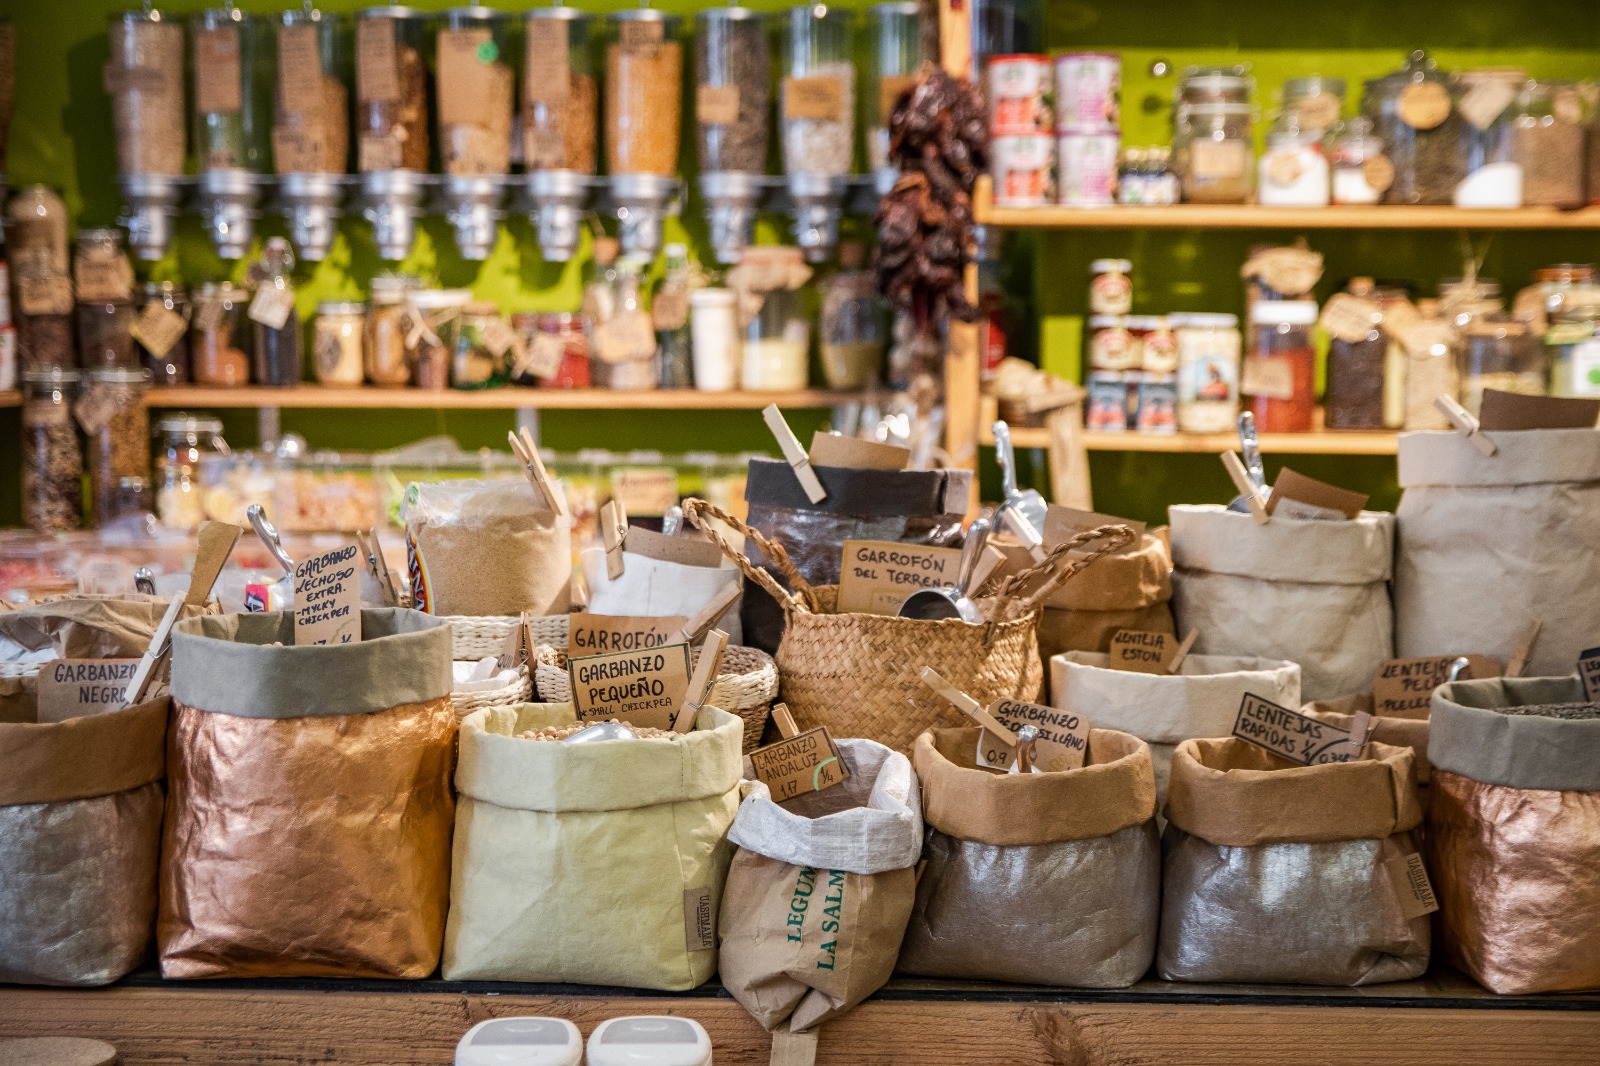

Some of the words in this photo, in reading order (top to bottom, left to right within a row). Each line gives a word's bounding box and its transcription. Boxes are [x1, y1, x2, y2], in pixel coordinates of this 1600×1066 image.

[296, 546, 357, 578] GARBANZO
[853, 567, 878, 579] DEL
[856, 547, 945, 573] GARROFÓN
[575, 627, 668, 651] GARROFÓN
[54, 663, 137, 683] GARBANZO
[579, 654, 665, 685] GARBANZO
[589, 677, 664, 705] PEQUEÑO
[589, 704, 615, 717] SMALL
[621, 697, 672, 713] CHICKPEA
[998, 701, 1079, 730] GARBANZO
[1247, 701, 1322, 738] LENTEJAS
[757, 736, 817, 770] GARBANZO
[764, 752, 820, 781] ANDALUZ
[699, 894, 713, 947] UASHMAMA
[816, 940, 838, 971] LA
